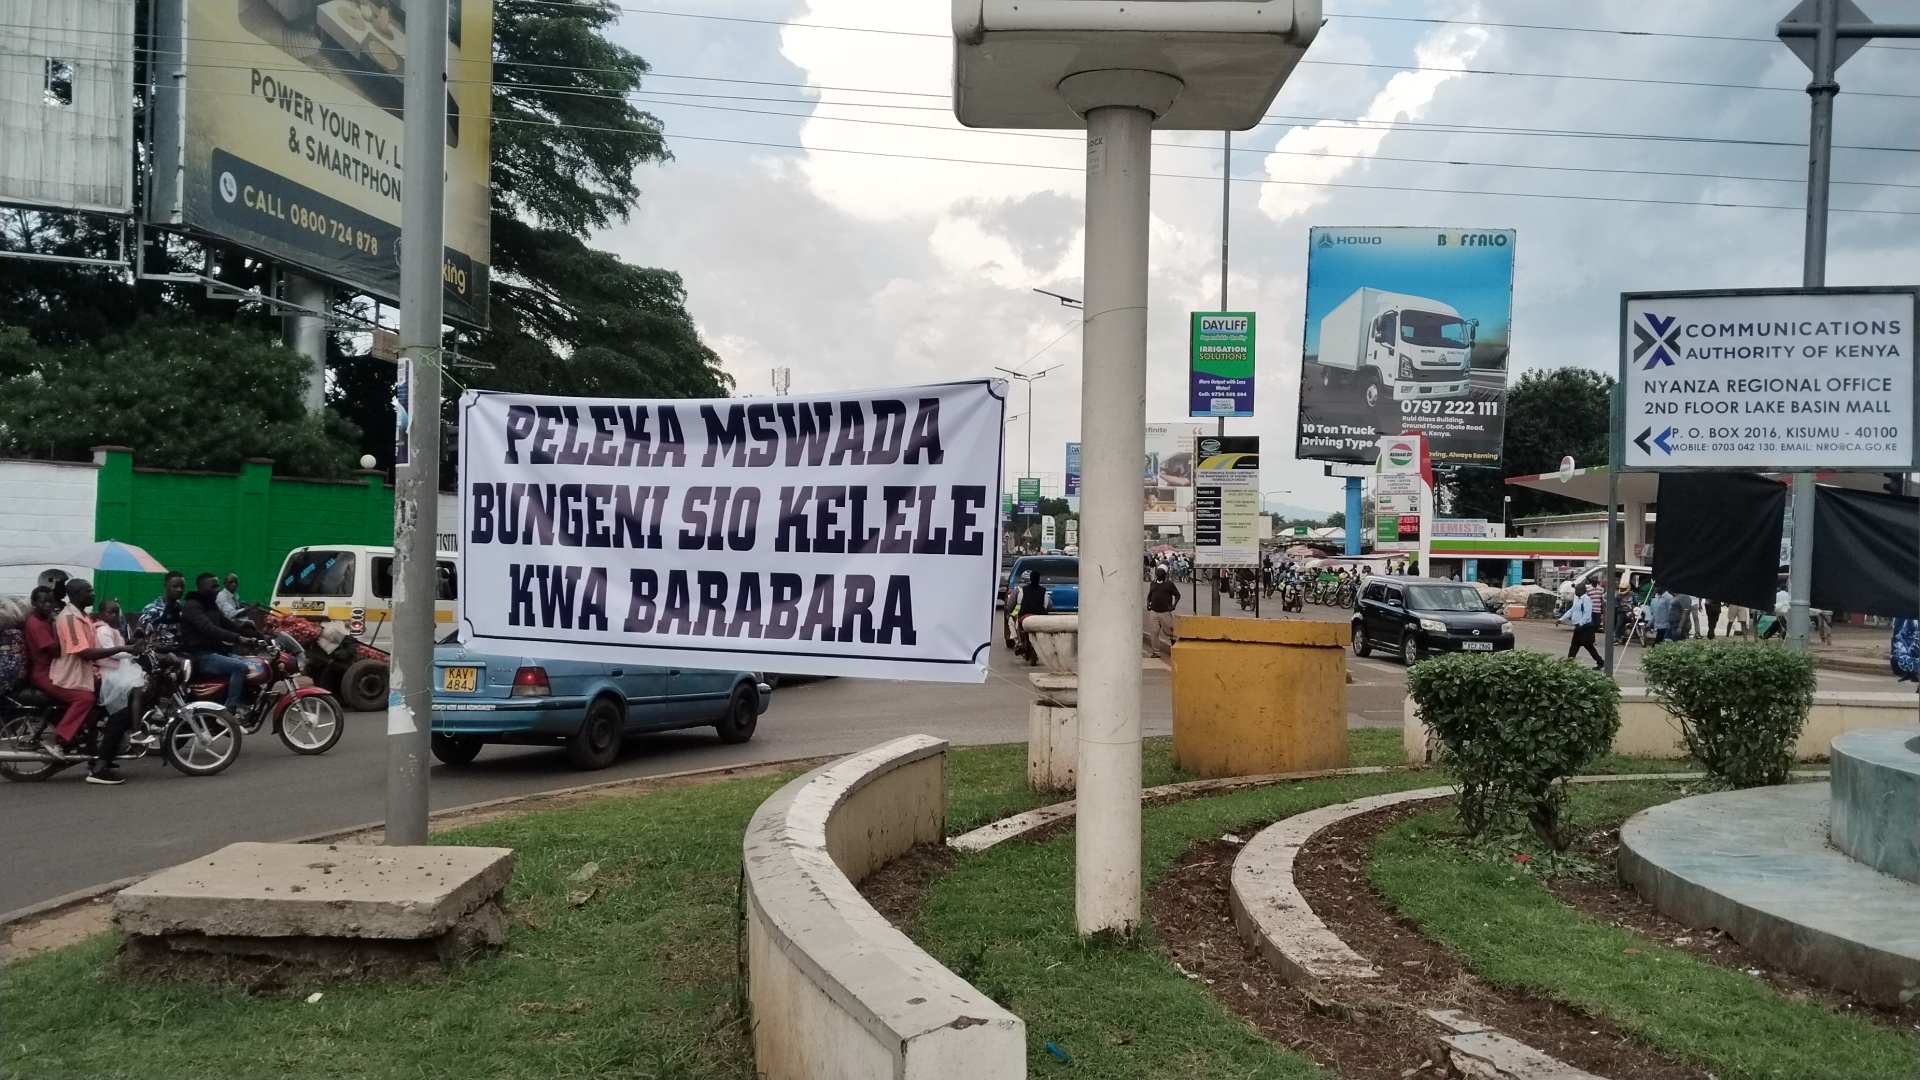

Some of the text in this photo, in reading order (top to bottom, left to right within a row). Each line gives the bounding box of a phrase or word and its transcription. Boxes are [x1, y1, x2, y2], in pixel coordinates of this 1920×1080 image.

[250, 68, 315, 126] POWER
[319, 103, 361, 153] YOUR
[288, 126, 301, 154] &
[305, 137, 402, 203] SMARTPHON
[243, 184, 379, 257] CALL 0800 724 878
[1336, 236, 1382, 245] HOWO
[1202, 320, 1247, 330] DAYLIFF
[1686, 320, 1901, 338] COMMUNICATIONS
[1686, 344, 1900, 360] AUTHORITY OF KENYA
[1644, 377, 1892, 394] NYANZA REGIONAL OFFICE
[1401, 400, 1498, 416] 0797 222 111
[1645, 400, 1891, 415] 2ND FLOOR LAKE BASIN MALL
[504, 398, 945, 468] PELEKA MSWADA
[1302, 424, 1376, 435] 10 Ton Truck
[1672, 427, 1683, 438] P.
[1688, 427, 1704, 438] O.
[1709, 427, 1739, 438] BOX
[1744, 427, 1781, 440] 2016,
[1786, 426, 1840, 438] KISUMU
[1854, 426, 1897, 438] 40100
[1302, 436, 1343, 449] Driving
[1345, 438, 1373, 450] Type
[1781, 443, 1813, 451] EMAIL:
[1816, 443, 1897, 451] NRO@CA.GO.KE
[471, 482, 987, 556] BUNGENI SIO KELELE
[1431, 524, 1479, 533] HEMIST
[508, 564, 917, 646] KWA BARABARA
[448, 668, 468, 679] KAV
[446, 680, 475, 691] 484J
